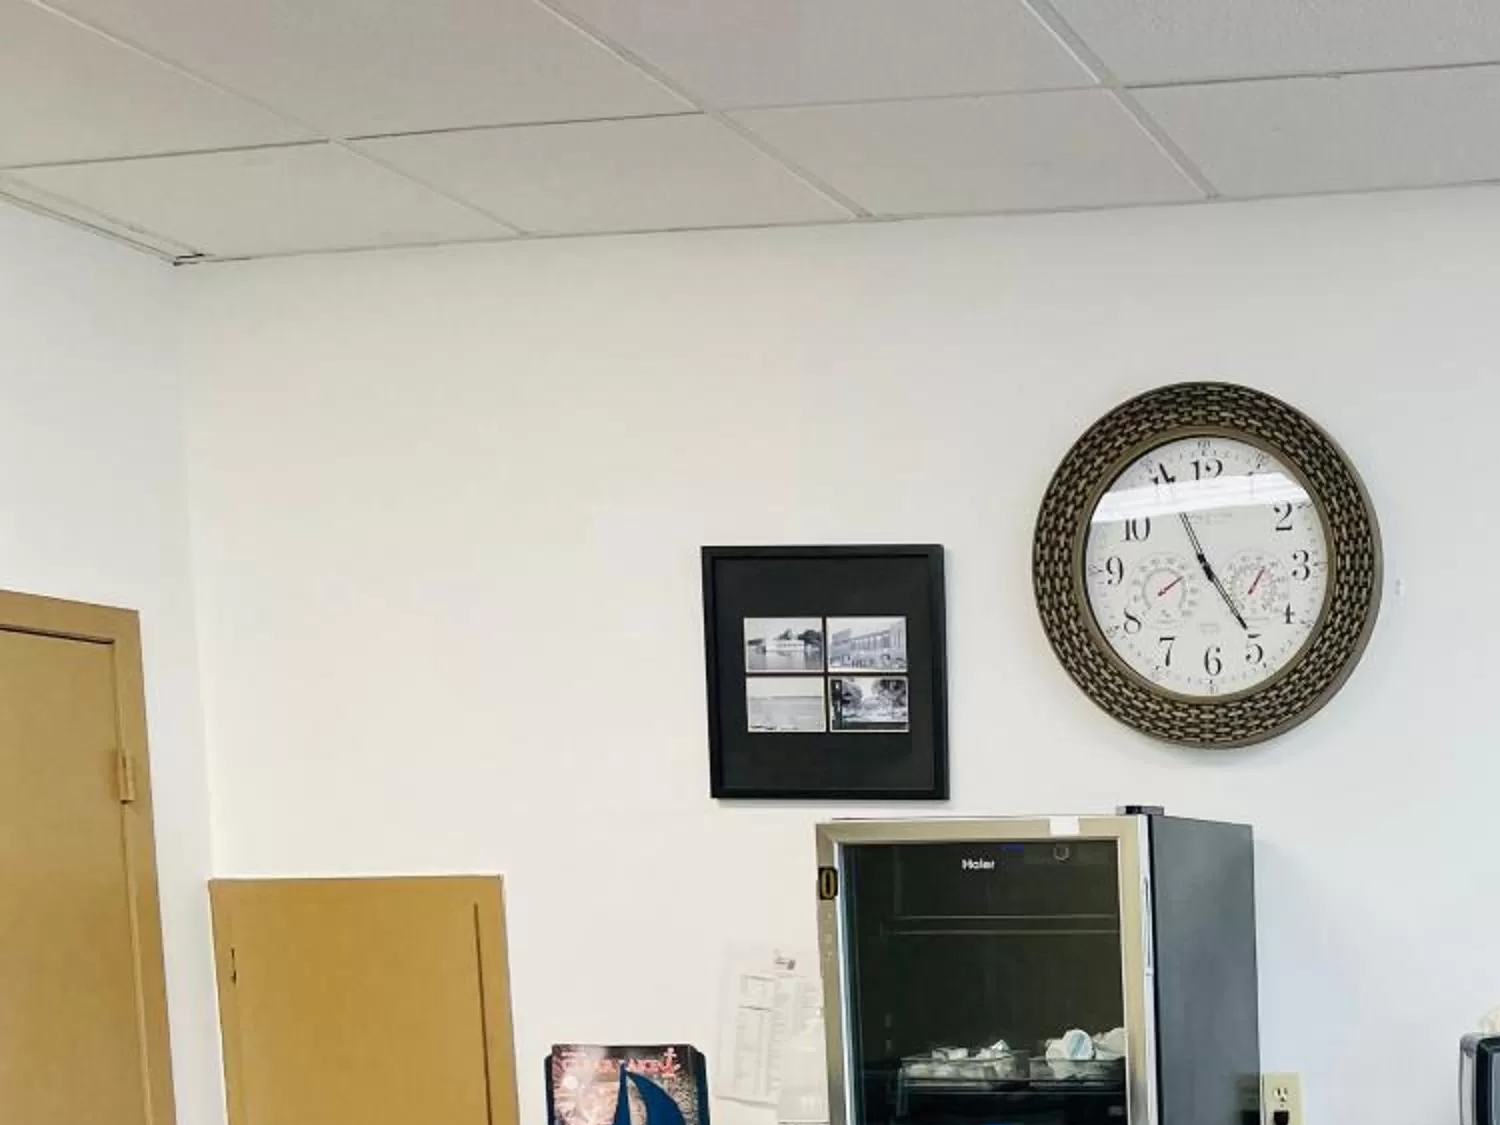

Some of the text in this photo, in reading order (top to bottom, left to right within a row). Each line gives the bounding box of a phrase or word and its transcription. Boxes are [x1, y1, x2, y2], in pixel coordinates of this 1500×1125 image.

[1122, 515, 1151, 541] 10
[1273, 500, 1293, 532] 2
[1105, 556, 1124, 585] 9
[1292, 548, 1311, 581] 3
[1123, 607, 1142, 634] 8
[1281, 602, 1295, 625] 4
[1159, 636, 1176, 667] 7
[1203, 646, 1222, 676] 6
[1245, 633, 1264, 665] 5
